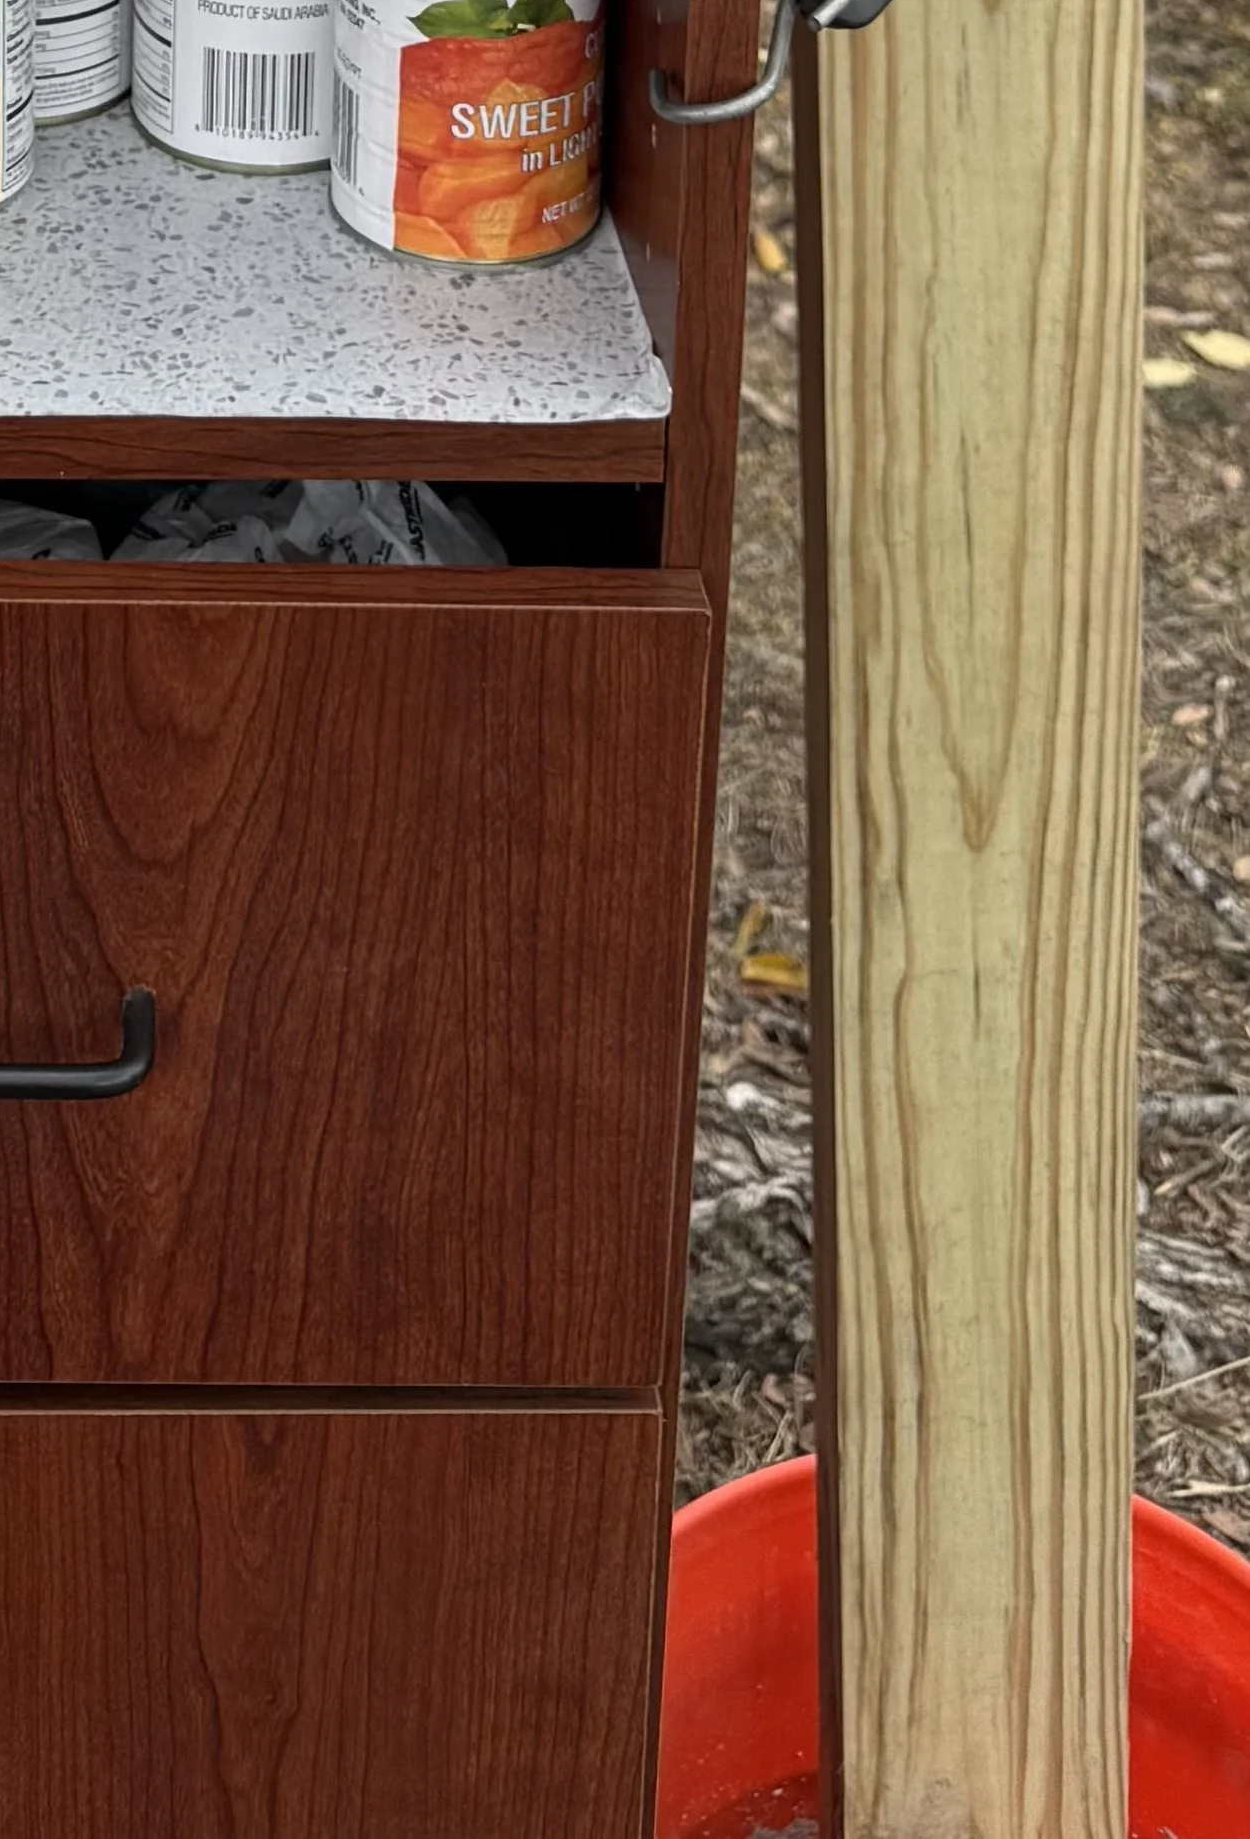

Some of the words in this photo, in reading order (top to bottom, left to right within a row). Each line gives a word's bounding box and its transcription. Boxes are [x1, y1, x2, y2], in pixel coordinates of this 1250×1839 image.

[246, 7, 261, 20] OF
[261, 7, 293, 20] SAUDI
[294, 3, 329, 20] ARABIA
[450, 92, 575, 139] SWEET
[521, 147, 544, 172] in
[542, 201, 566, 224] NET
